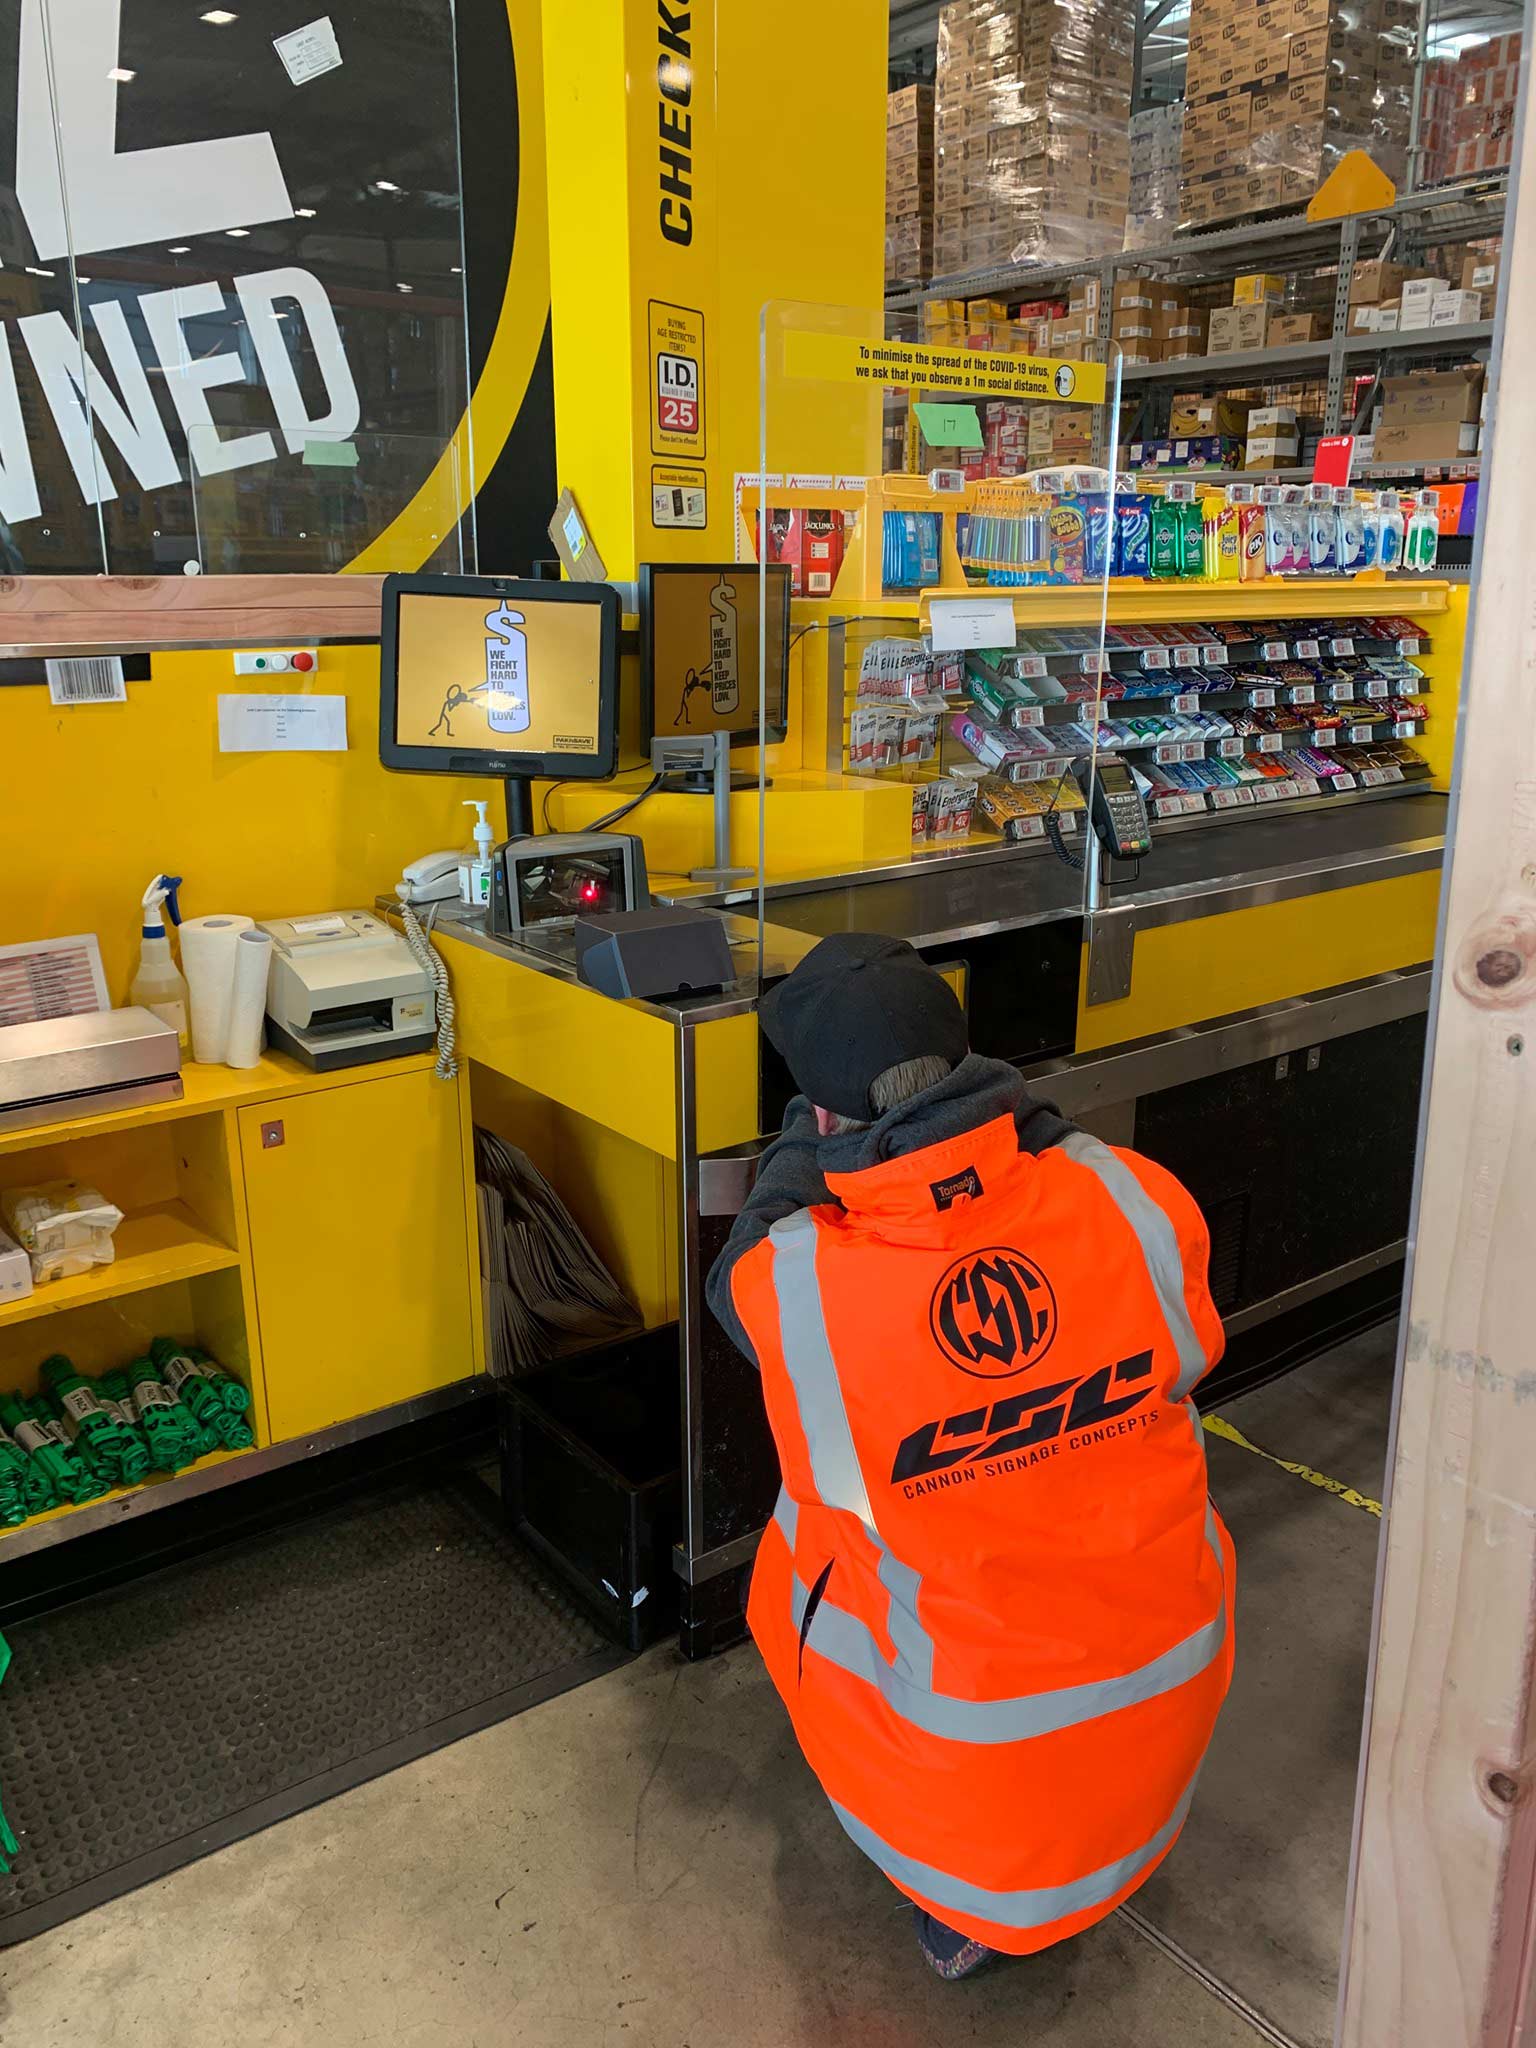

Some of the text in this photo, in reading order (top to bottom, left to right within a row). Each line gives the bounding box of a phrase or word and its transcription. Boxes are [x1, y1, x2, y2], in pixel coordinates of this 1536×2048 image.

[667, 318, 686, 330] BUYING
[657, 327, 697, 344] AGE RESTRICTED
[860, 346, 1050, 378] To minimise the spread of the COVID-19 virus,
[664, 361, 694, 388] I.D.
[856, 366, 1049, 393] we ask that you observe a 1m social distance.
[664, 400, 694, 427] 25
[713, 628, 724, 639] WE
[713, 638, 732, 649] FIGHT
[490, 650, 506, 660] WE
[713, 650, 732, 661] HARD
[490, 660, 519, 670] FIGHT
[714, 661, 723, 671] TO
[490, 671, 518, 680] HARD
[714, 671, 730, 682] KEEP
[491, 681, 504, 690] TO
[714, 680, 737, 692] PRICES
[492, 711, 517, 721] LOW.
[941, 788, 977, 808] Energizer
[938, 1176, 975, 1197] Tornado
[1069, 1409, 1160, 1451] CONCEPTS
[985, 1443, 1061, 1478] SIGNAGE
[903, 1467, 976, 1500] CANNON
